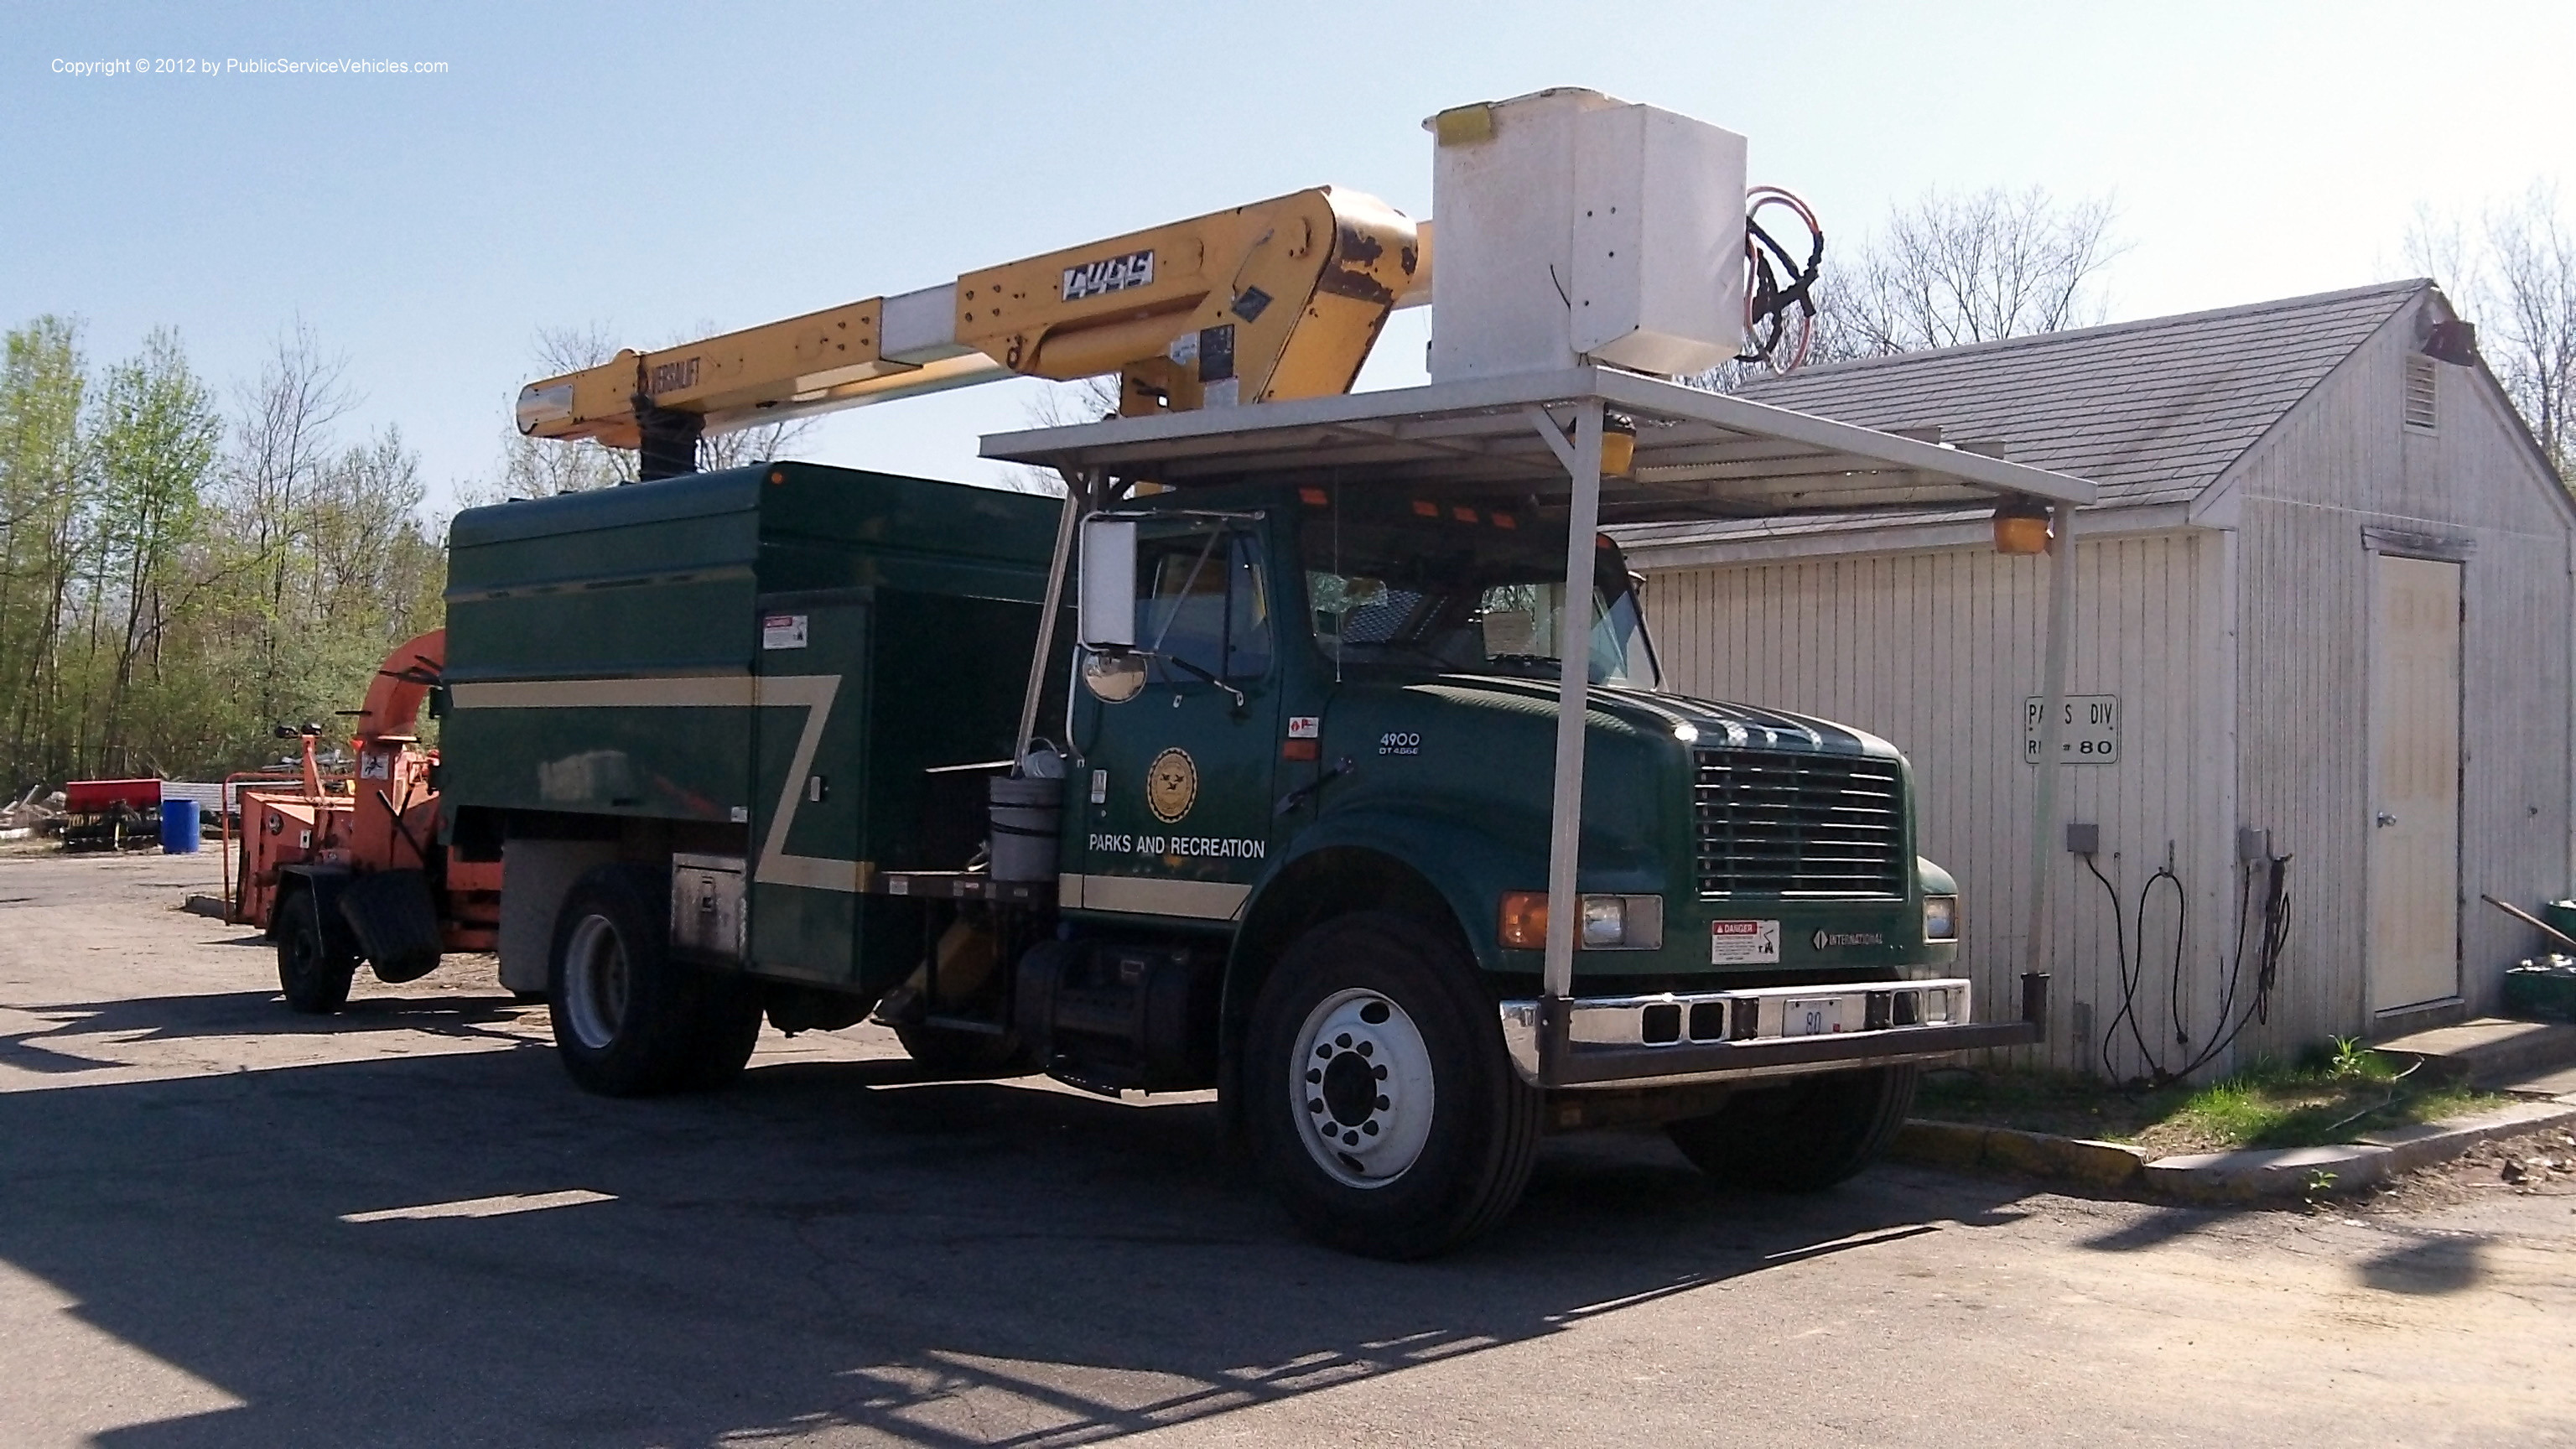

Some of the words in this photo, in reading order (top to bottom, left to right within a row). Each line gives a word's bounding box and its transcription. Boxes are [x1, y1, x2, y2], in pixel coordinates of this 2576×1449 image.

[2090, 703, 2112, 724] DIV
[1380, 733, 1420, 745] 4900
[2080, 740, 2112, 754] 80
[1089, 834, 1132, 853] PARKS
[1136, 836, 1166, 854] AND
[1171, 837, 1265, 859] RECREATION
[1724, 923, 1753, 933] DANGER
[1805, 1011, 1821, 1036] 80
